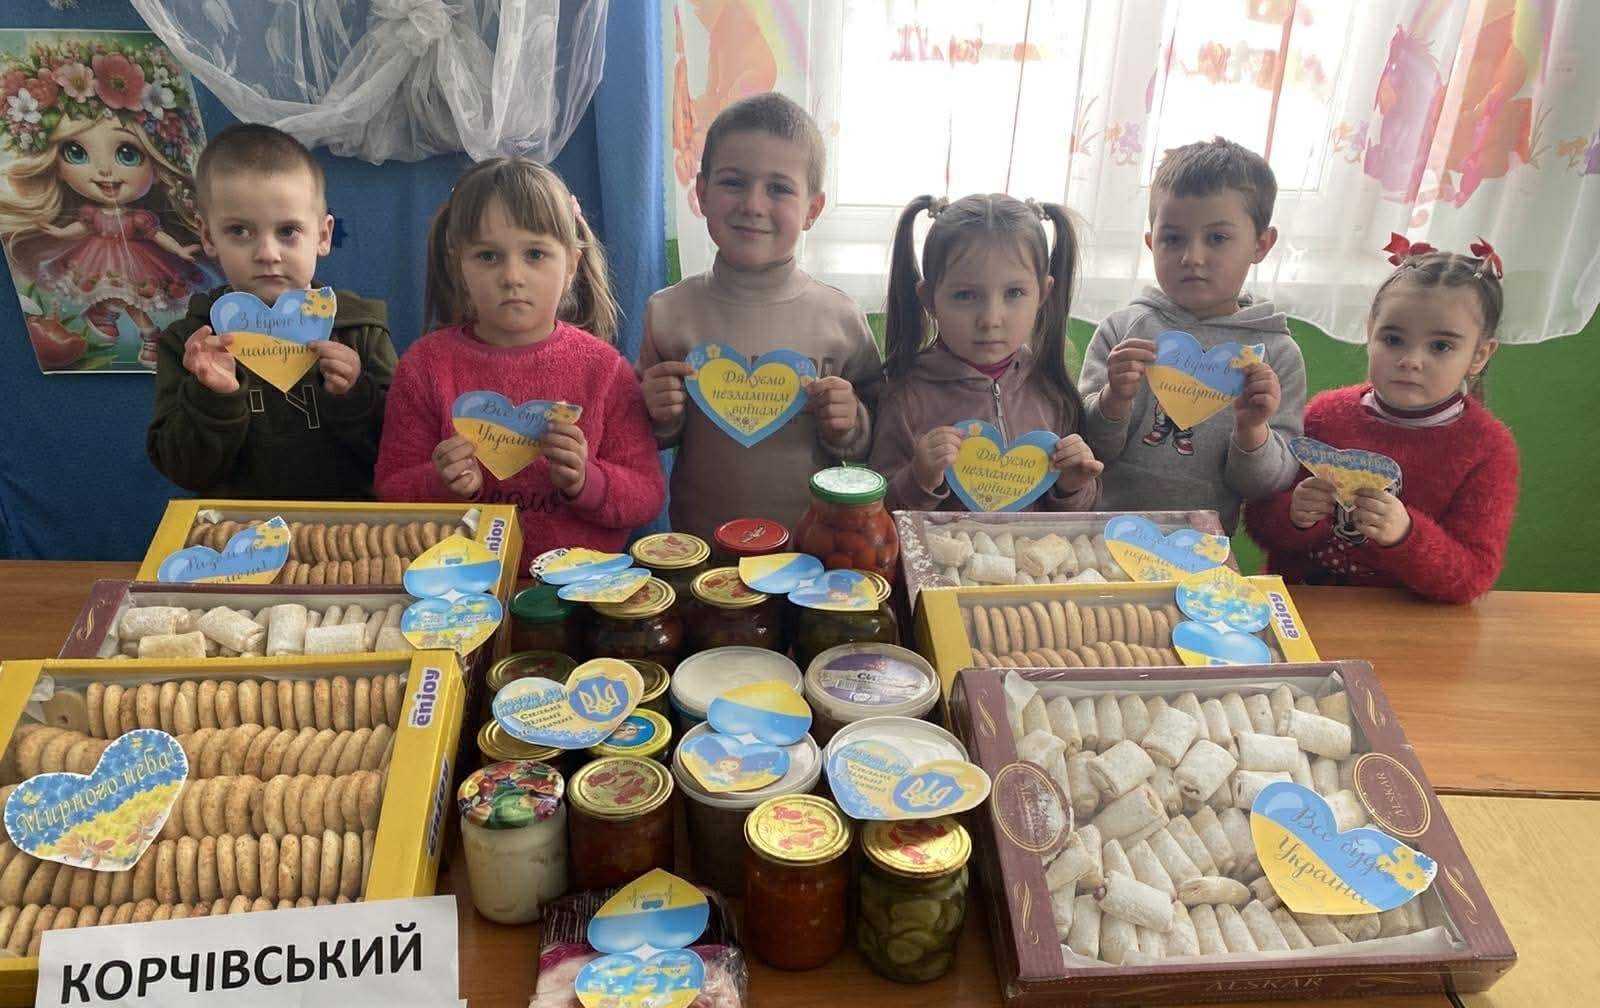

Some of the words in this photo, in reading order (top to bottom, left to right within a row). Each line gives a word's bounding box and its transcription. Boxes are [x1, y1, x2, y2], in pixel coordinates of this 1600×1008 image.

[712, 388, 791, 403] незламним
[723, 370, 786, 389] Дякуємо
[415, 669, 440, 726] enjoy
[16, 780, 119, 838] Мирного
[122, 743, 177, 786] неба!
[1290, 806, 1333, 842] Все
[60, 921, 422, 1005] КОРЧІВСЬКИЙ
